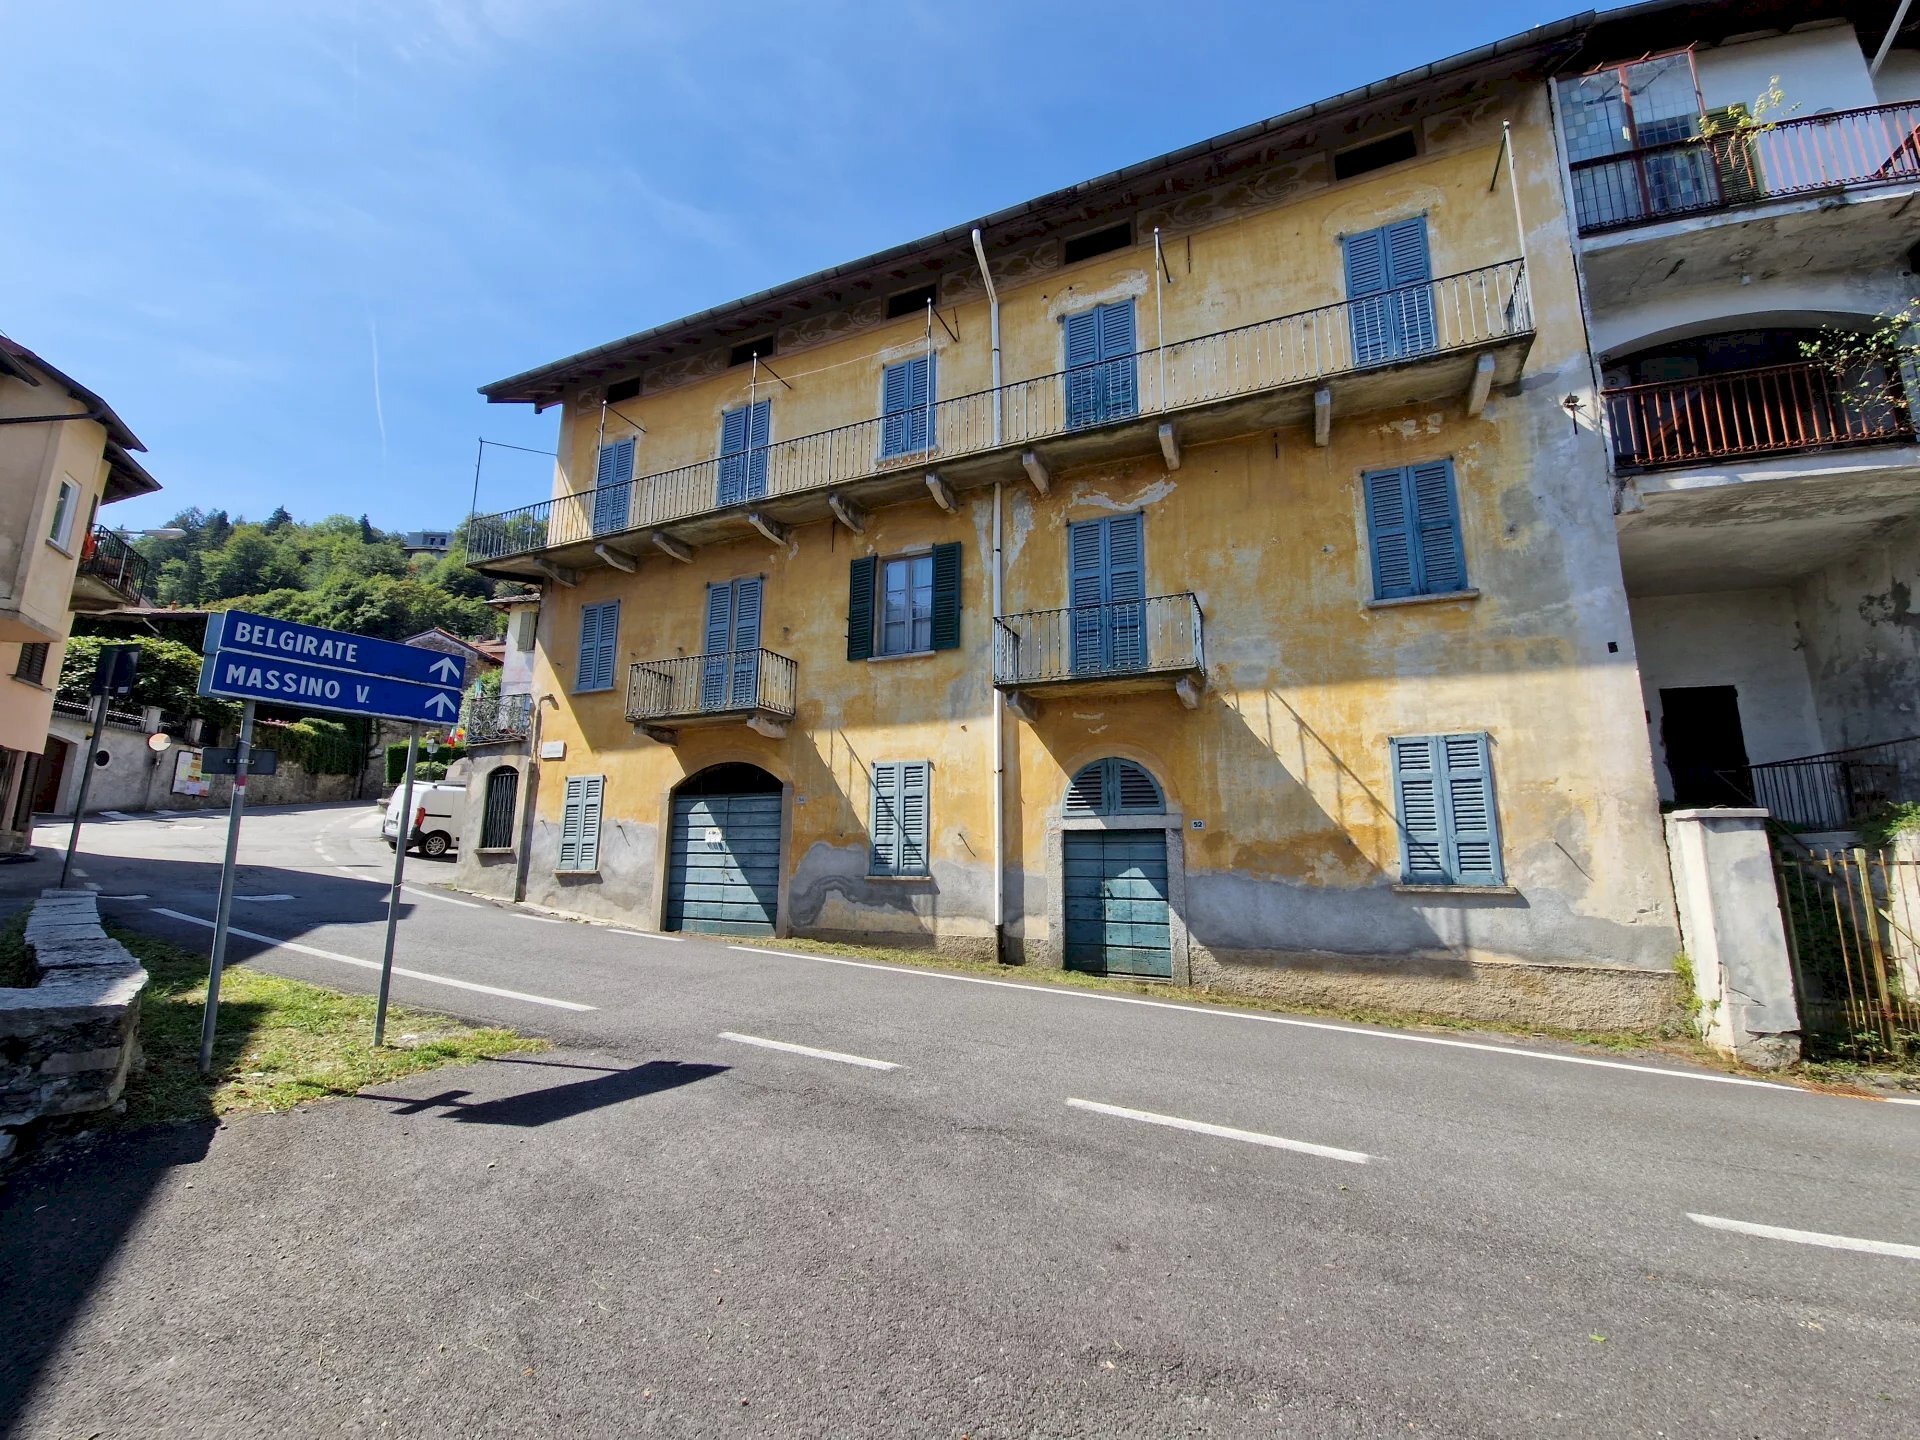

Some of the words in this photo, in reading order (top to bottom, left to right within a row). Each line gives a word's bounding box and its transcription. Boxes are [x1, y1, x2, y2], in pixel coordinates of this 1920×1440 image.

[235, 621, 358, 662] BELGIRATE
[226, 664, 341, 699] MASSINO
[356, 685, 370, 703] V.
